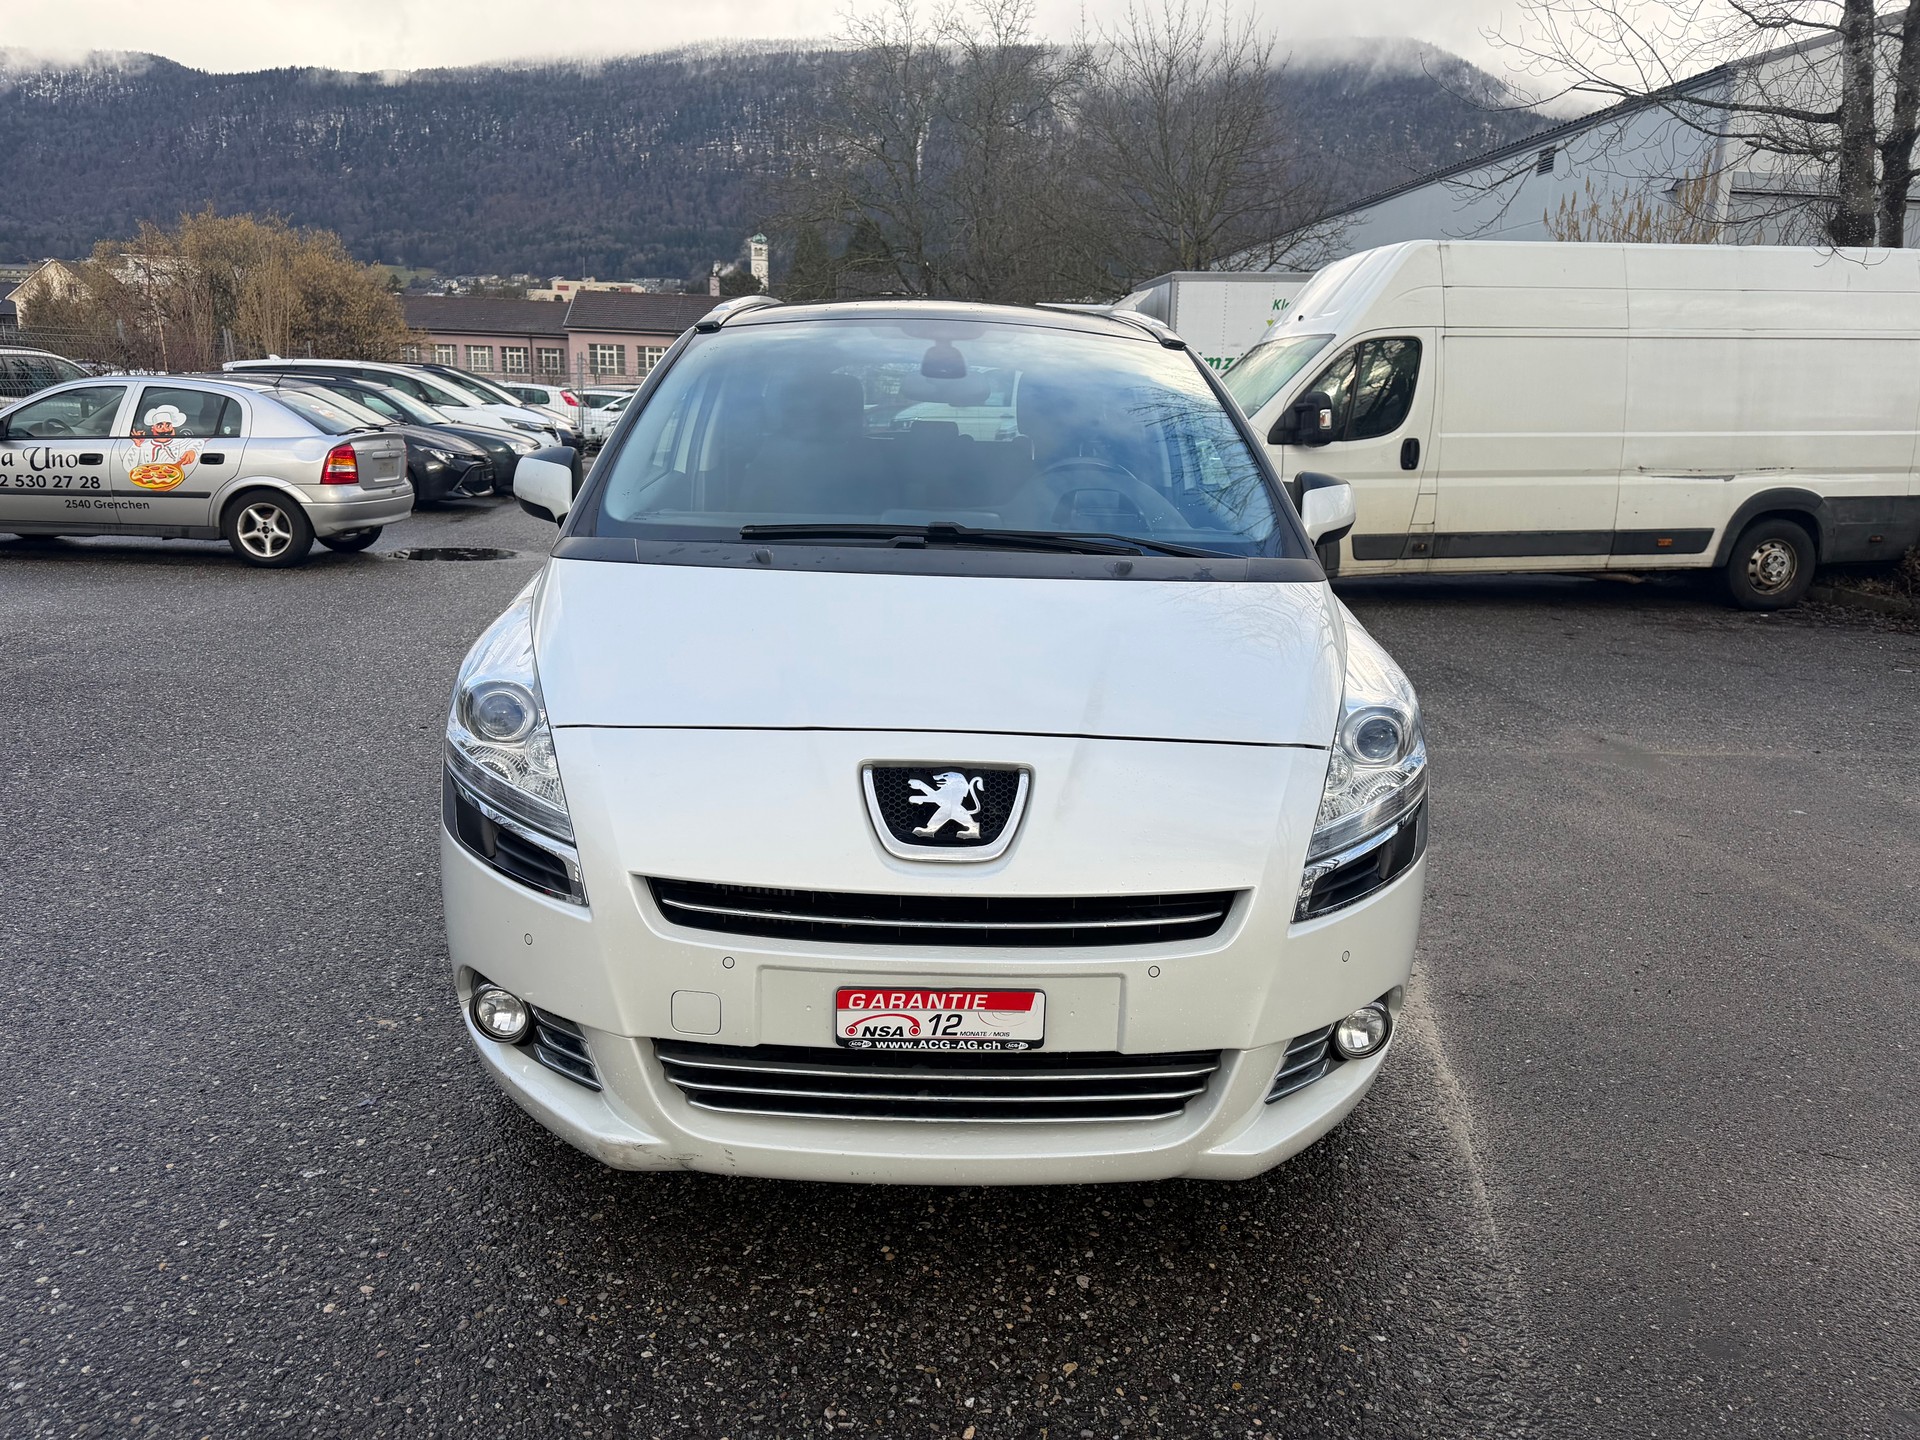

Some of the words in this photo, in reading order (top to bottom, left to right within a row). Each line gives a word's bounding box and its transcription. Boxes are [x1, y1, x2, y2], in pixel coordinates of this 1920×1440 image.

[22, 446, 78, 472] Uno
[15, 474, 47, 488] 530
[52, 475, 73, 489] 27
[79, 476, 101, 489] 28
[64, 499, 91, 509] 2540
[93, 500, 150, 509] Grenchen
[848, 993, 988, 1010] GARANTIE
[861, 1025, 904, 1038] NSA
[928, 1013, 963, 1036] 12
[875, 1040, 1001, 1050] www.ACG-AG.ch
